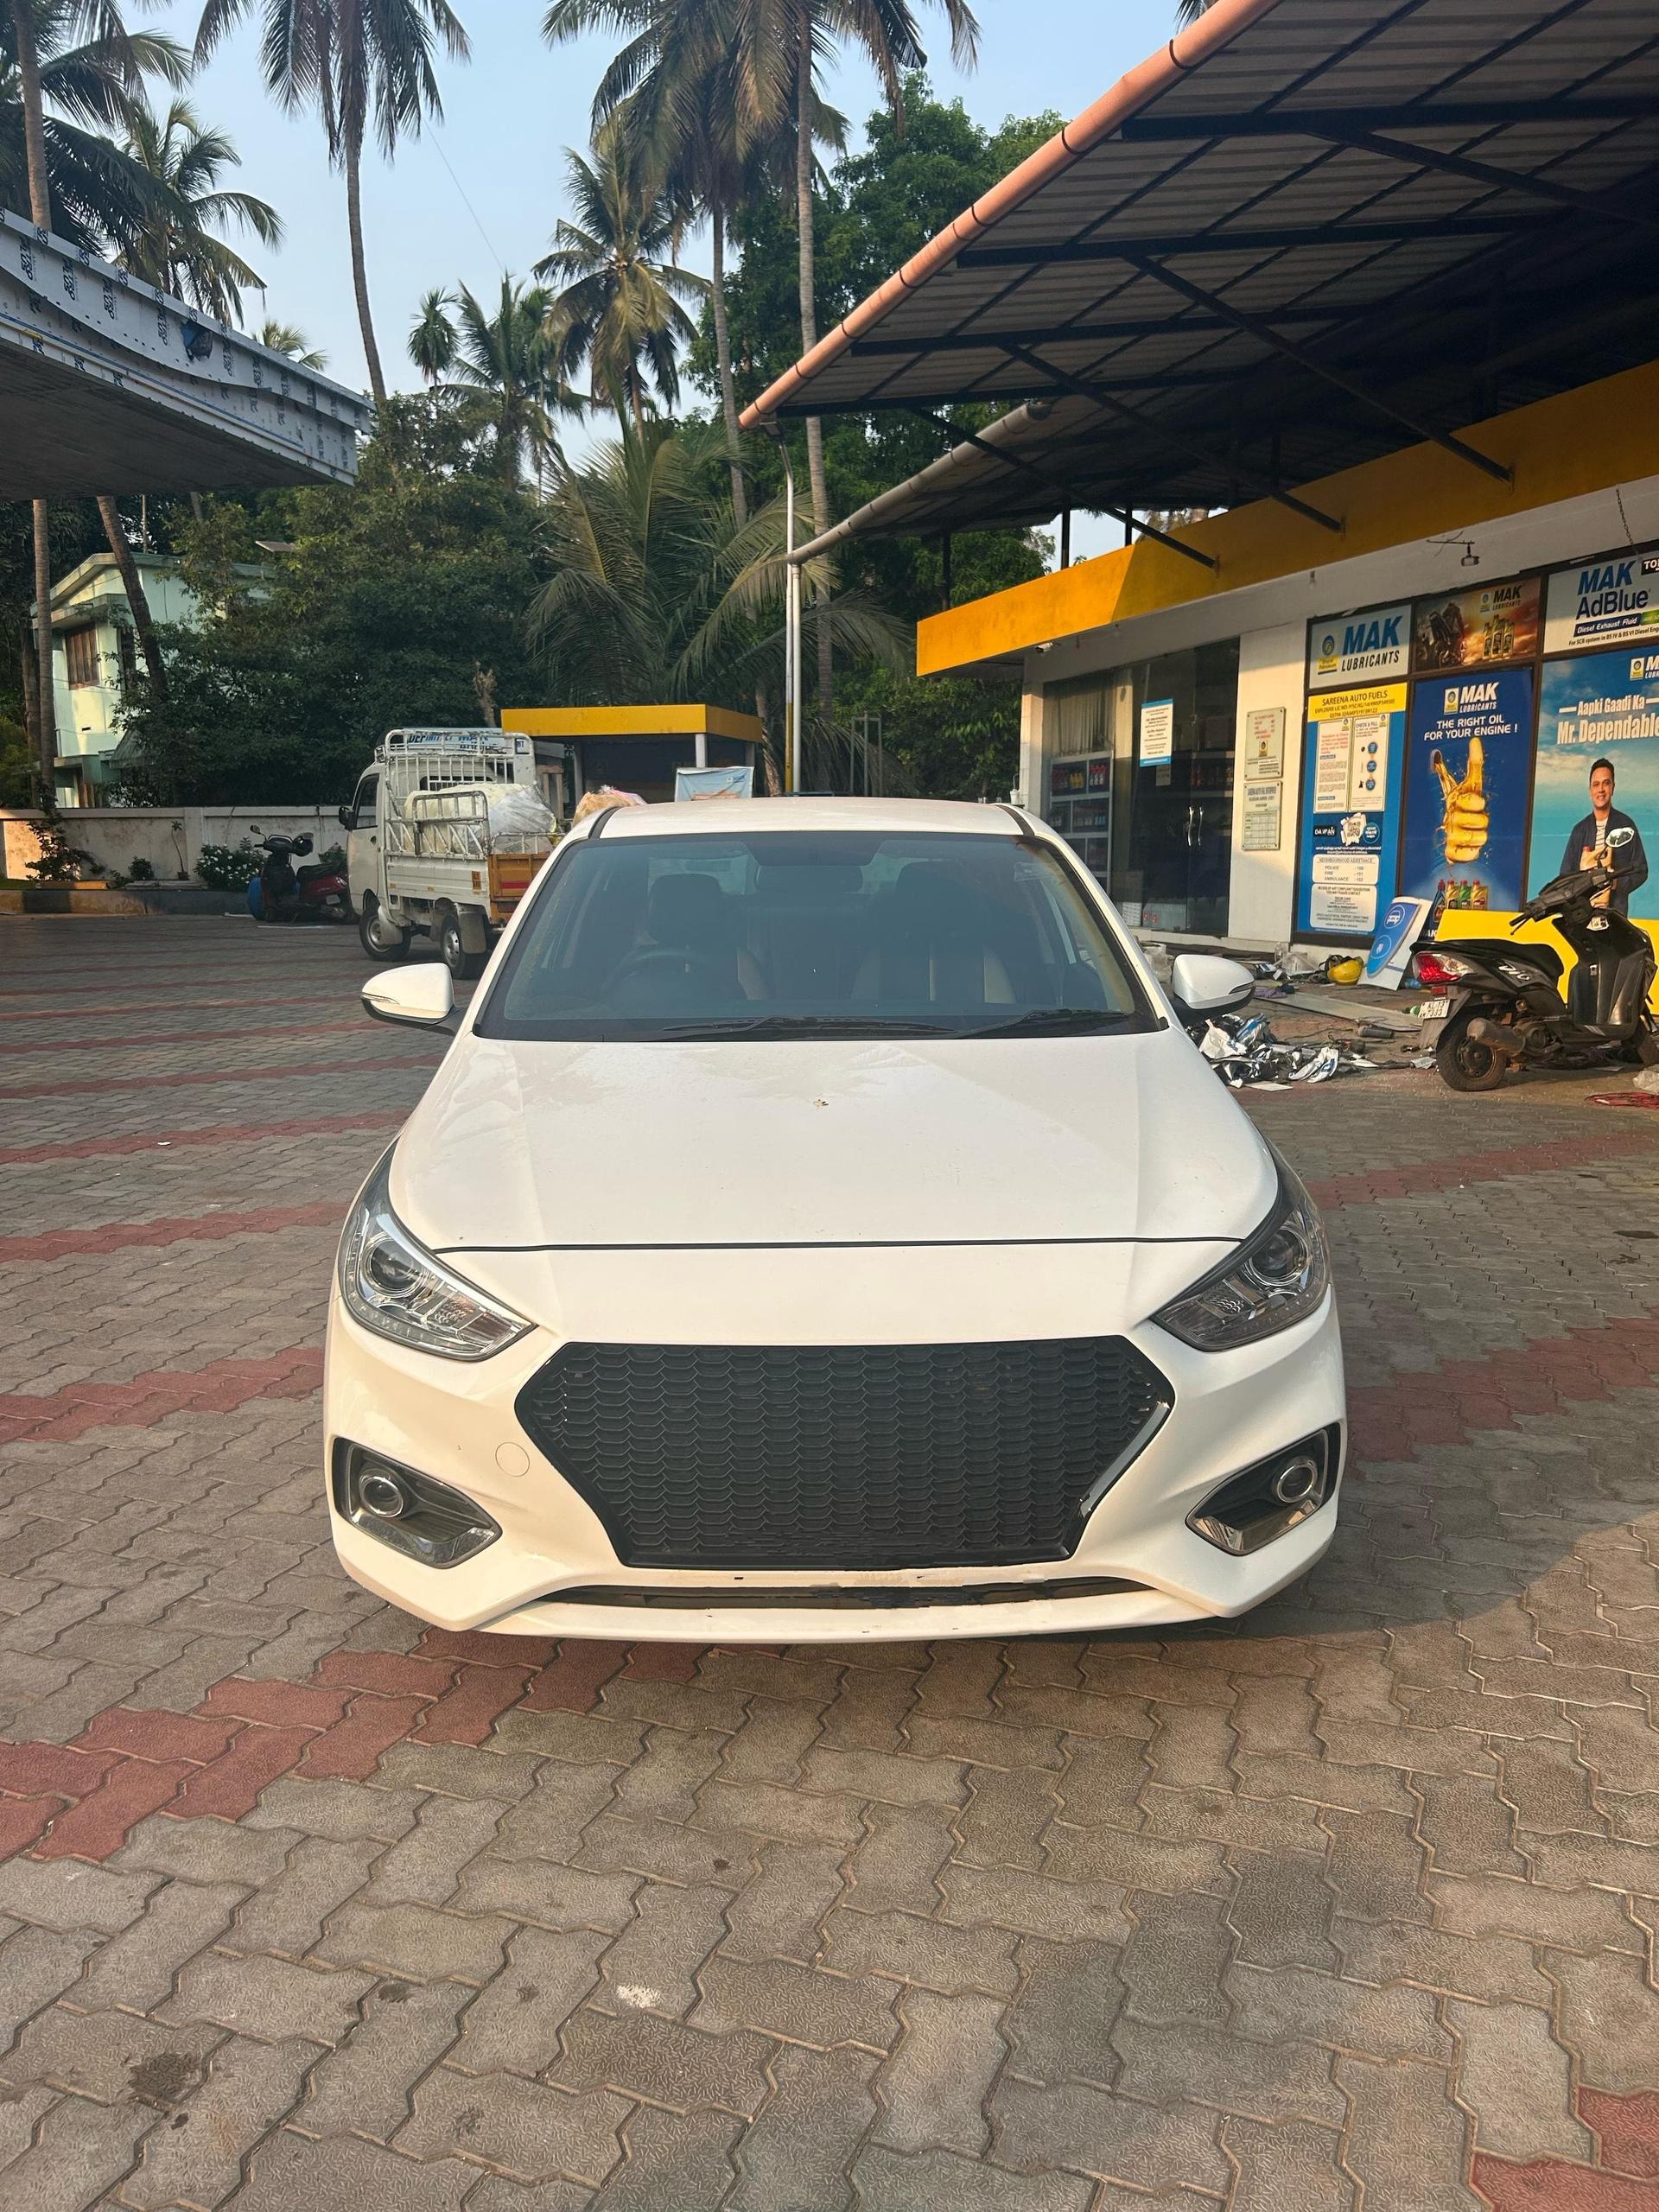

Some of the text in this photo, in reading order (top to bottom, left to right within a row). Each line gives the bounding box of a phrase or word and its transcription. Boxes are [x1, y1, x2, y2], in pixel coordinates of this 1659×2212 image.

[1643, 559, 1659, 569] TO
[1577, 560, 1637, 595] MAK
[1493, 585, 1522, 603] MAK
[1576, 589, 1649, 620] AdBlue
[1577, 617, 1638, 634] Diesel Exhaust Fluid
[1342, 615, 1403, 656] MAK
[1341, 650, 1400, 672] LUBRICANTS
[1322, 696, 1348, 706] SAREENA
[1350, 693, 1367, 702] AUTO
[1369, 690, 1388, 700] FUELS
[1460, 682, 1499, 703] MAK
[1459, 702, 1497, 714] LUBRICANTS
[1578, 695, 1645, 715] Aapki Gaadi Ka
[1436, 714, 1505, 729] THE RIGHT OIL
[1424, 724, 1517, 741] FOR YOUR ENGINE !
[1557, 721, 1576, 745] Mr.
